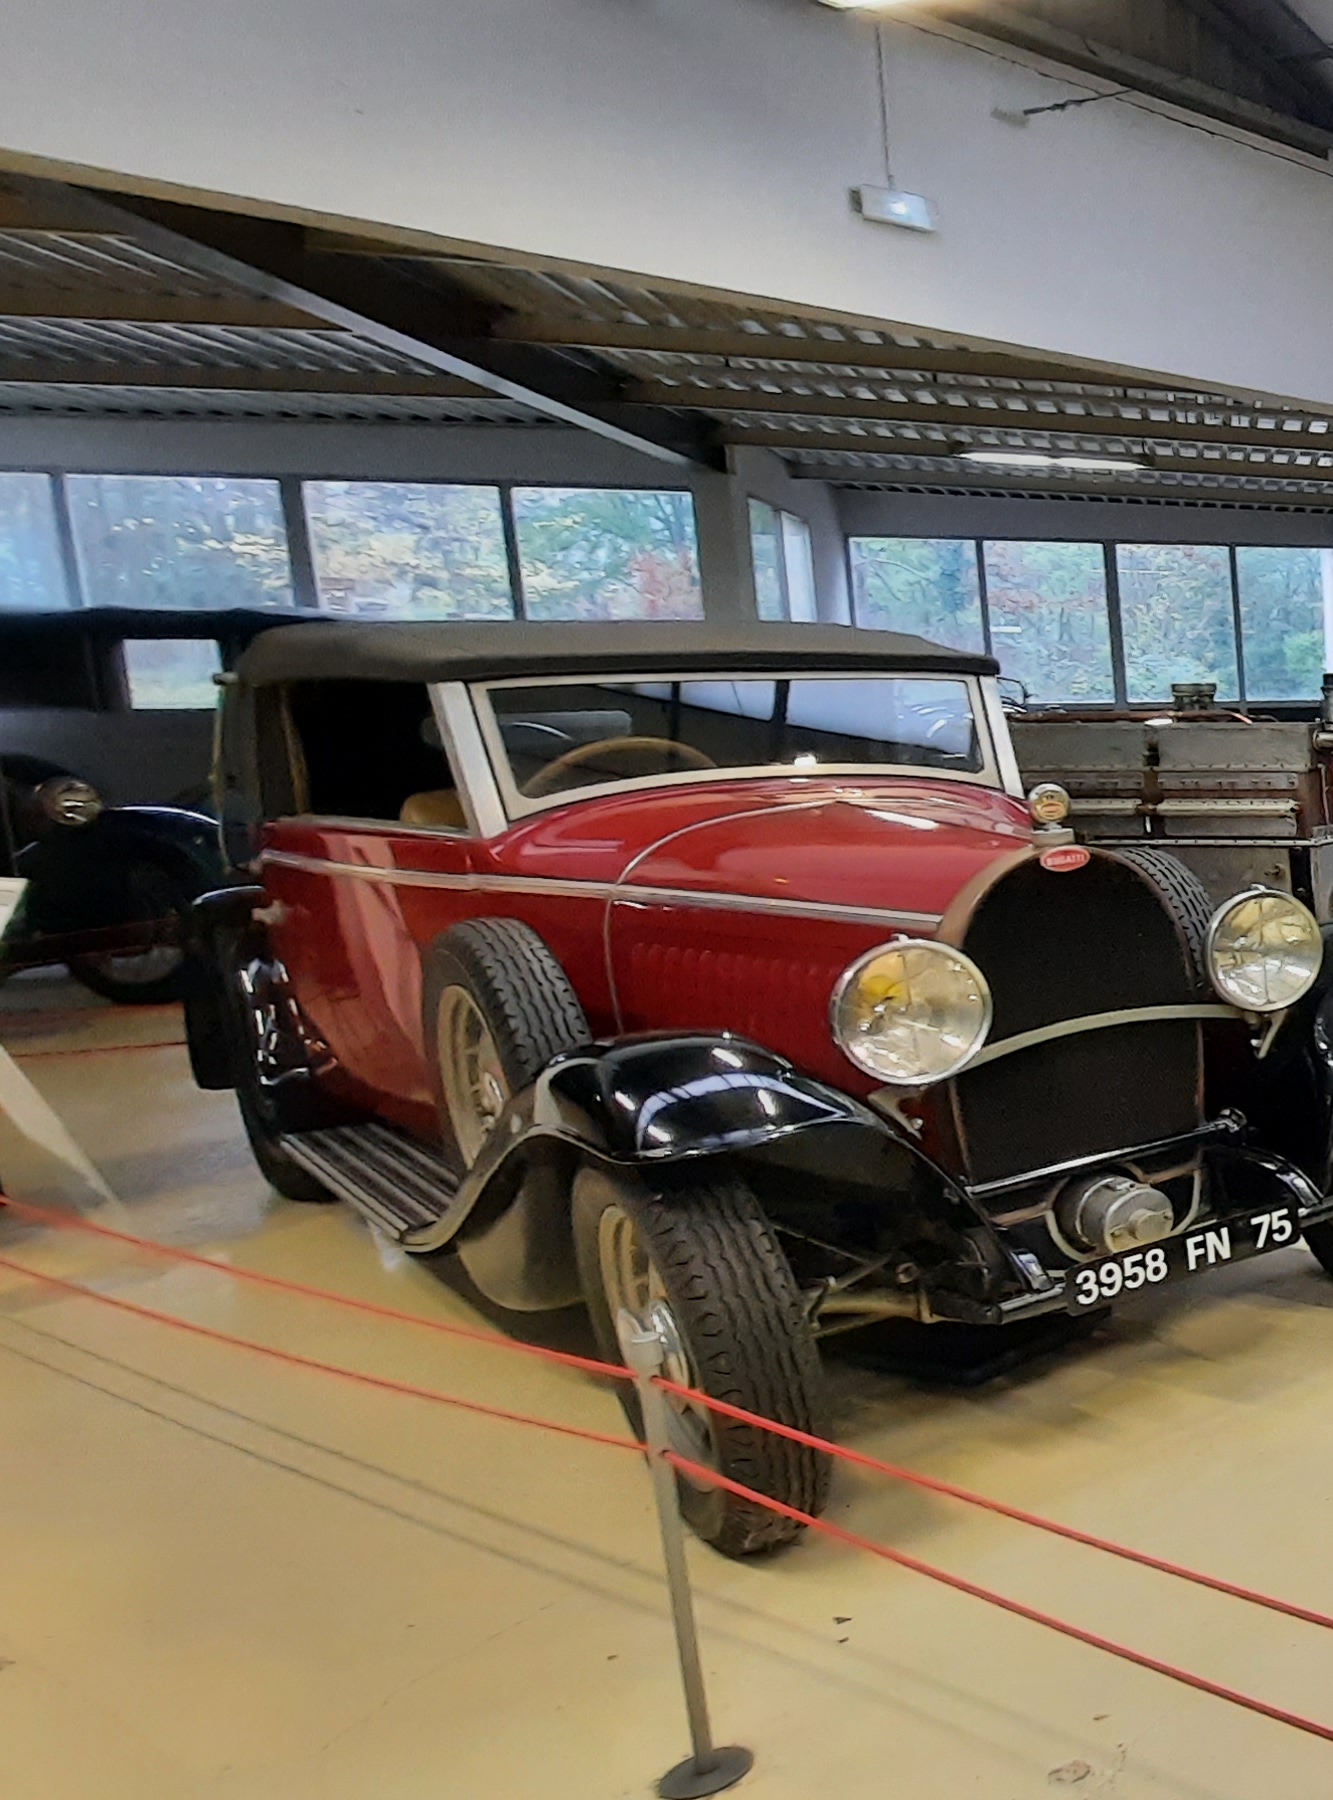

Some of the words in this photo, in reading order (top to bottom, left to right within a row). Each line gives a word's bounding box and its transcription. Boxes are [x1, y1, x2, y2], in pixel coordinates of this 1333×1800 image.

[1075, 1248, 1168, 1305] 3958
[1185, 1227, 1232, 1271] FN
[1250, 1208, 1292, 1249] 75
